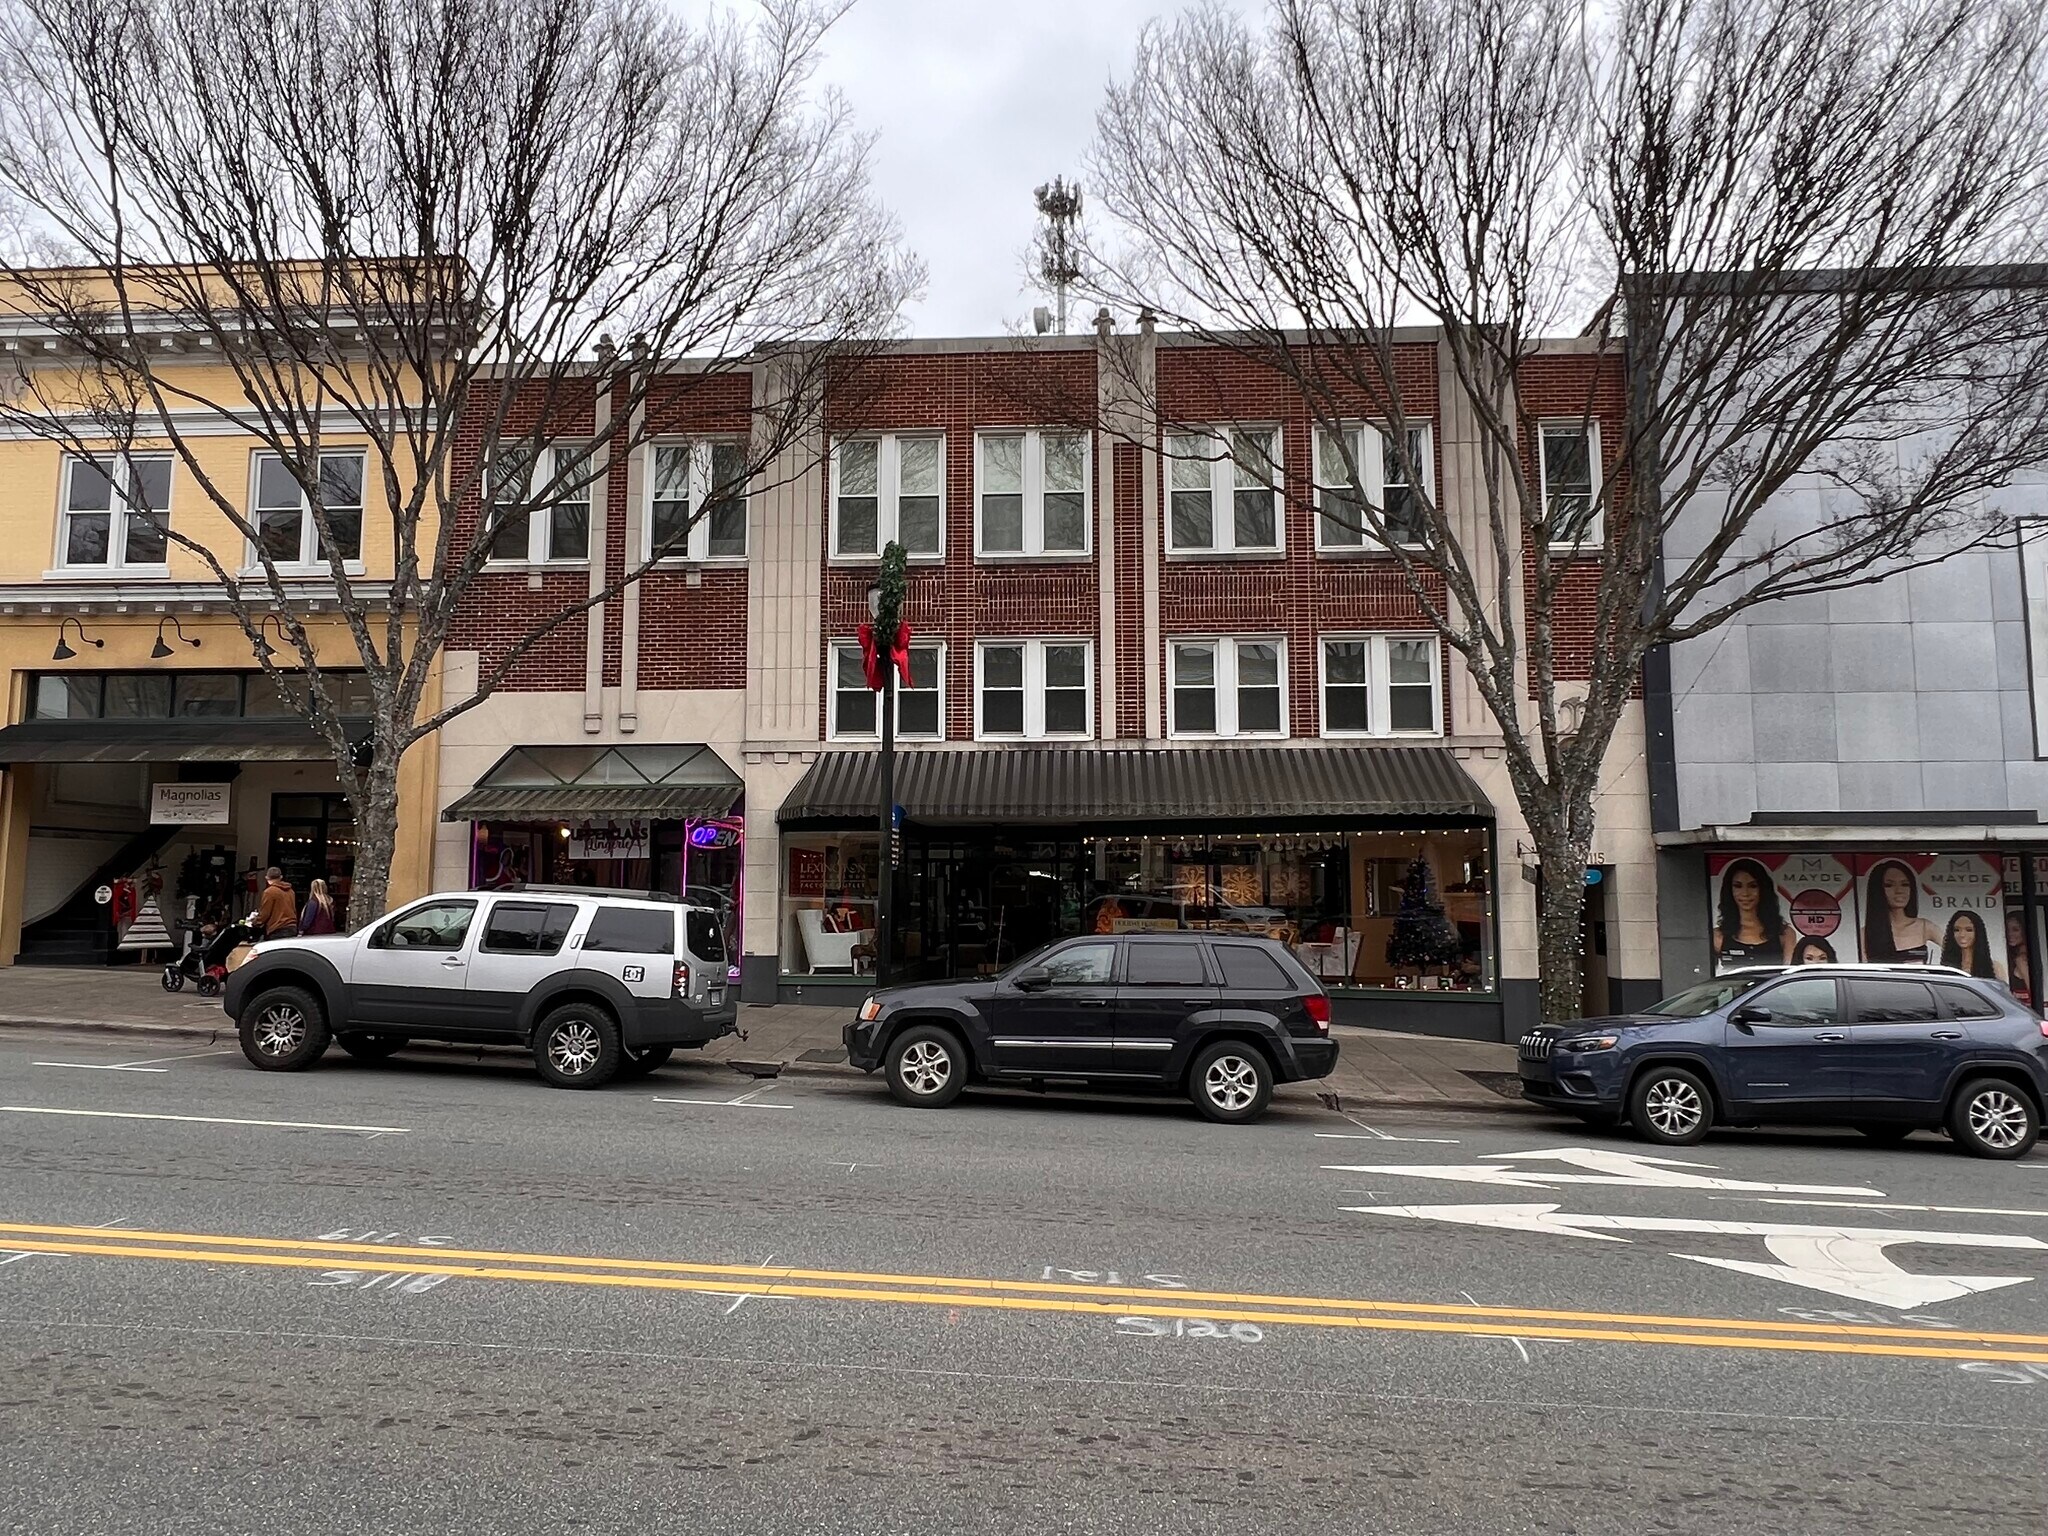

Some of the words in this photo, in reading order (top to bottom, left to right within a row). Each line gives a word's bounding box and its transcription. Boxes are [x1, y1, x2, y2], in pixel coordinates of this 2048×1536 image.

[160, 788, 221, 804] Magnolias
[571, 827, 648, 841] UPPERCLAS
[691, 826, 737, 847] OPEN
[588, 835, 647, 854] Lingerie
[1588, 852, 1605, 864] 115
[1783, 873, 1844, 882] MAYDE
[1931, 874, 1992, 883] MAYDE
[1932, 896, 1997, 909] BRAID
[1807, 915, 1825, 924] HD
[1115, 1316, 1264, 1344] S120
